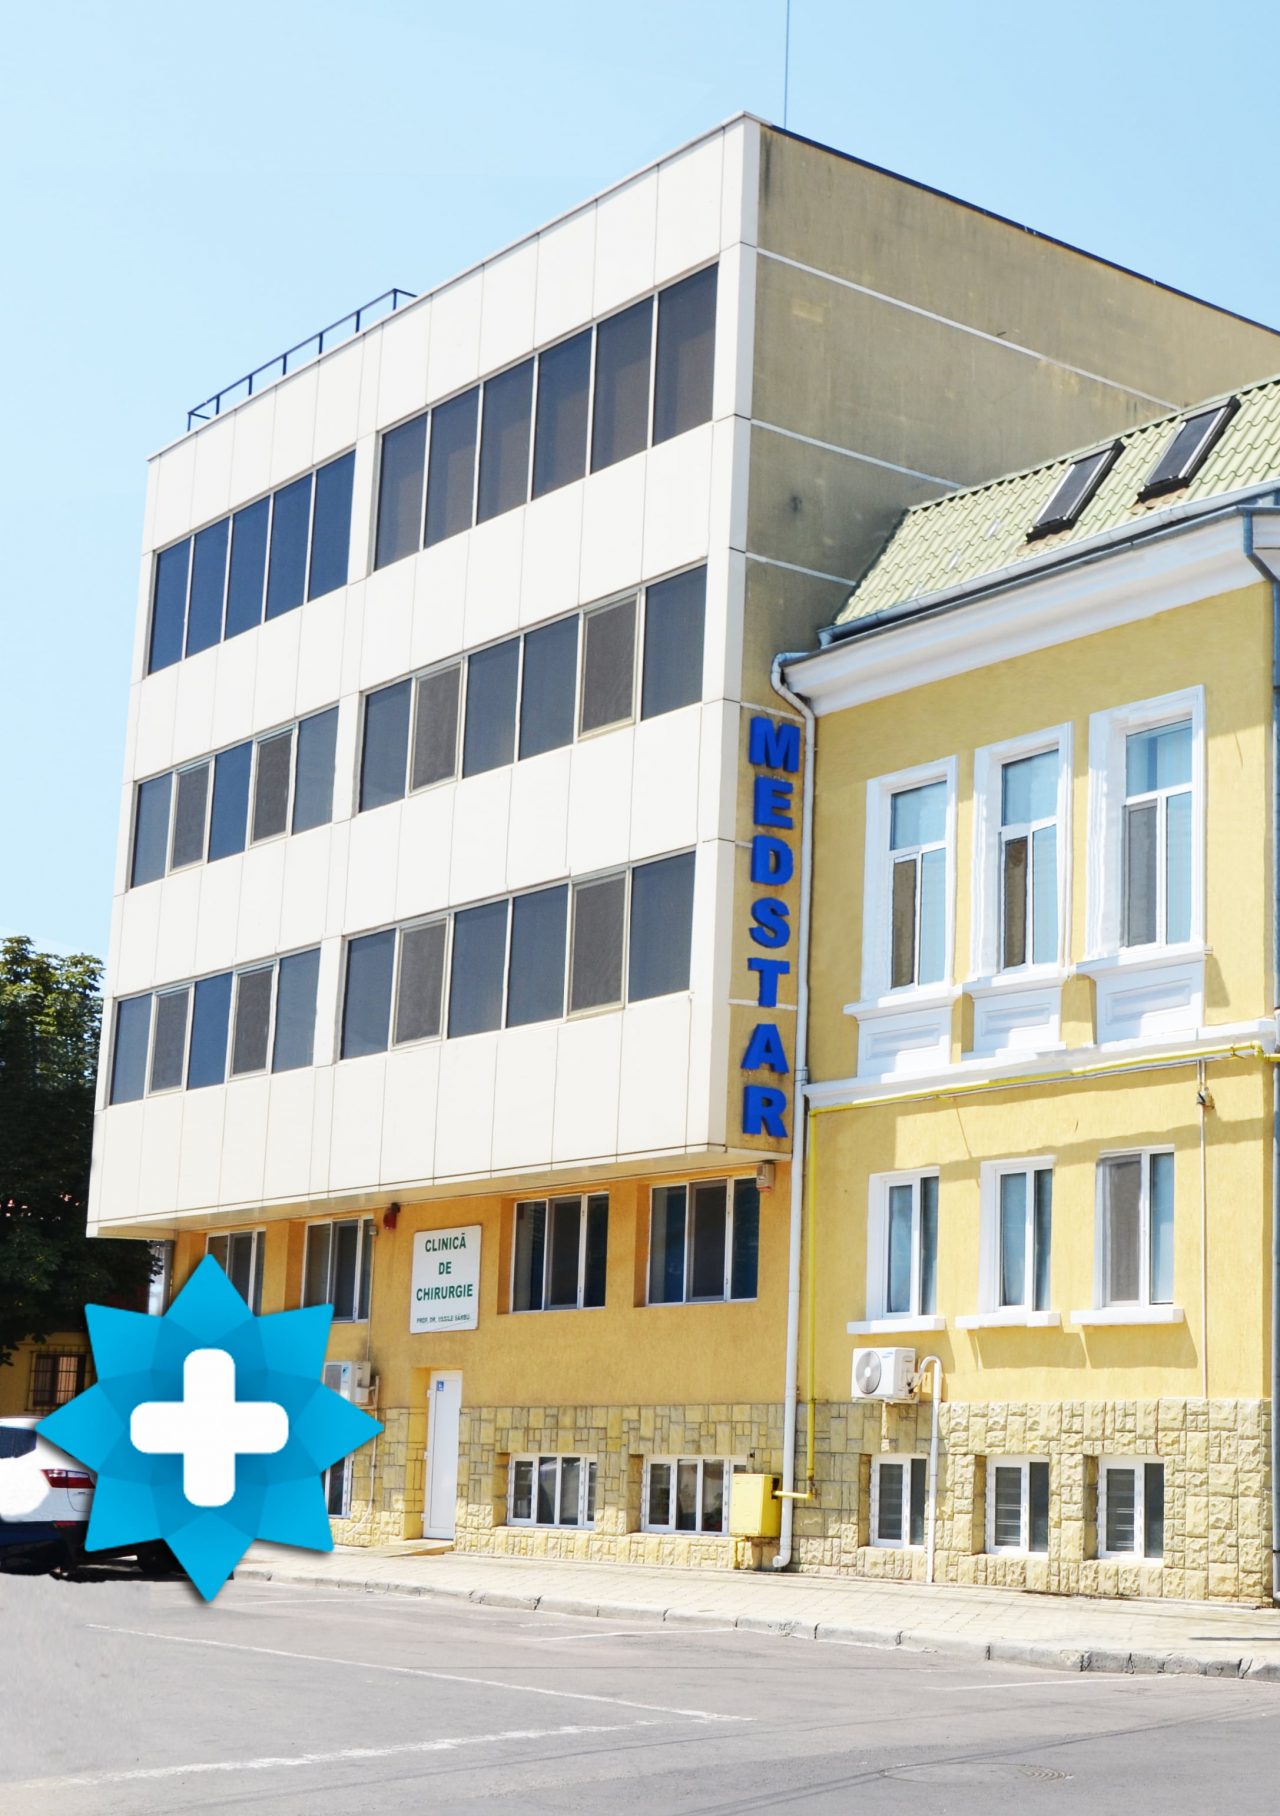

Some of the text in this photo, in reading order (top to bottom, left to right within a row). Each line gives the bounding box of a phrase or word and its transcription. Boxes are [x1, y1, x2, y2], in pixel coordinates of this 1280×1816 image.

[741, 715, 801, 1138] MEDSTAR
[425, 1232, 467, 1252] CLINICĂ
[438, 1261, 452, 1275] DE
[416, 1284, 473, 1301] CHIRURGIE
